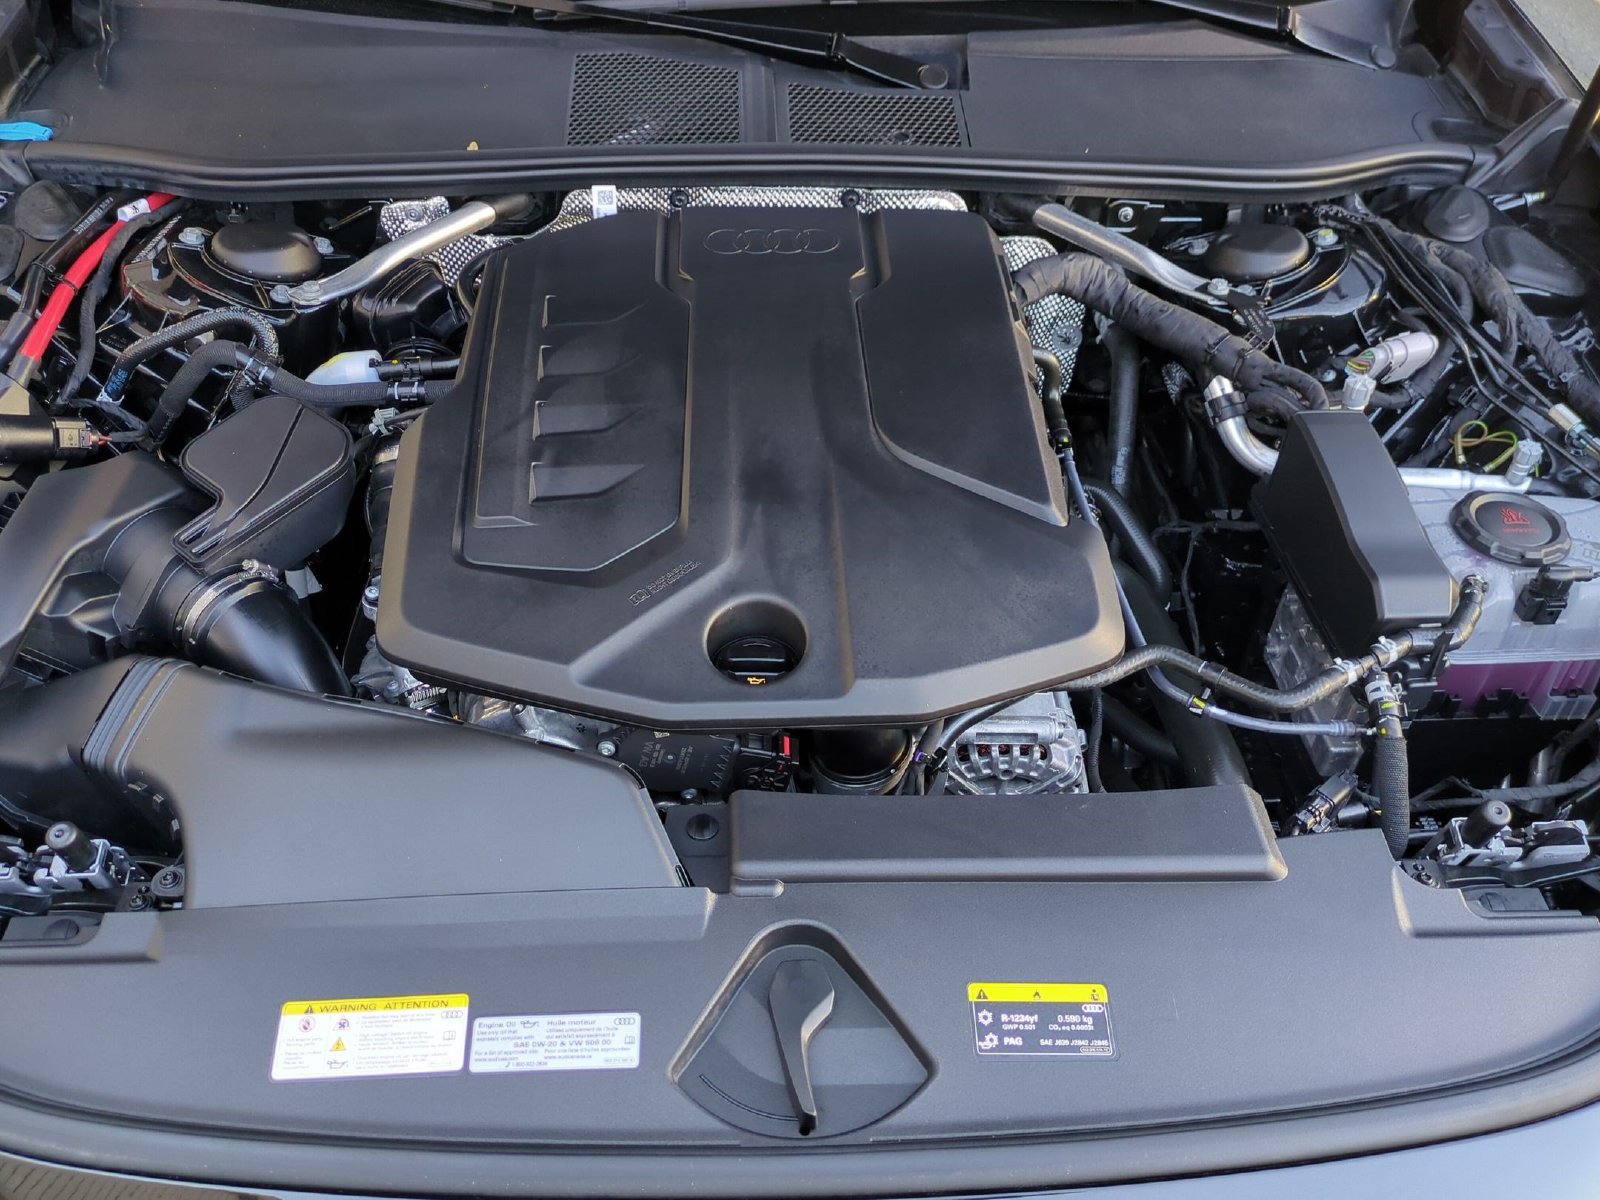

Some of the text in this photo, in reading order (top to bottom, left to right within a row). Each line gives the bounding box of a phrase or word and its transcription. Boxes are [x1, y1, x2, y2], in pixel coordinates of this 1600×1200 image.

[319, 999, 449, 1013] WARNING ATTENTION
[1001, 1013, 1039, 1024] R-1234yf
[1082, 1014, 1093, 1024] kg
[478, 1021, 503, 1029] Engine
[1003, 1036, 1023, 1046] PAG
